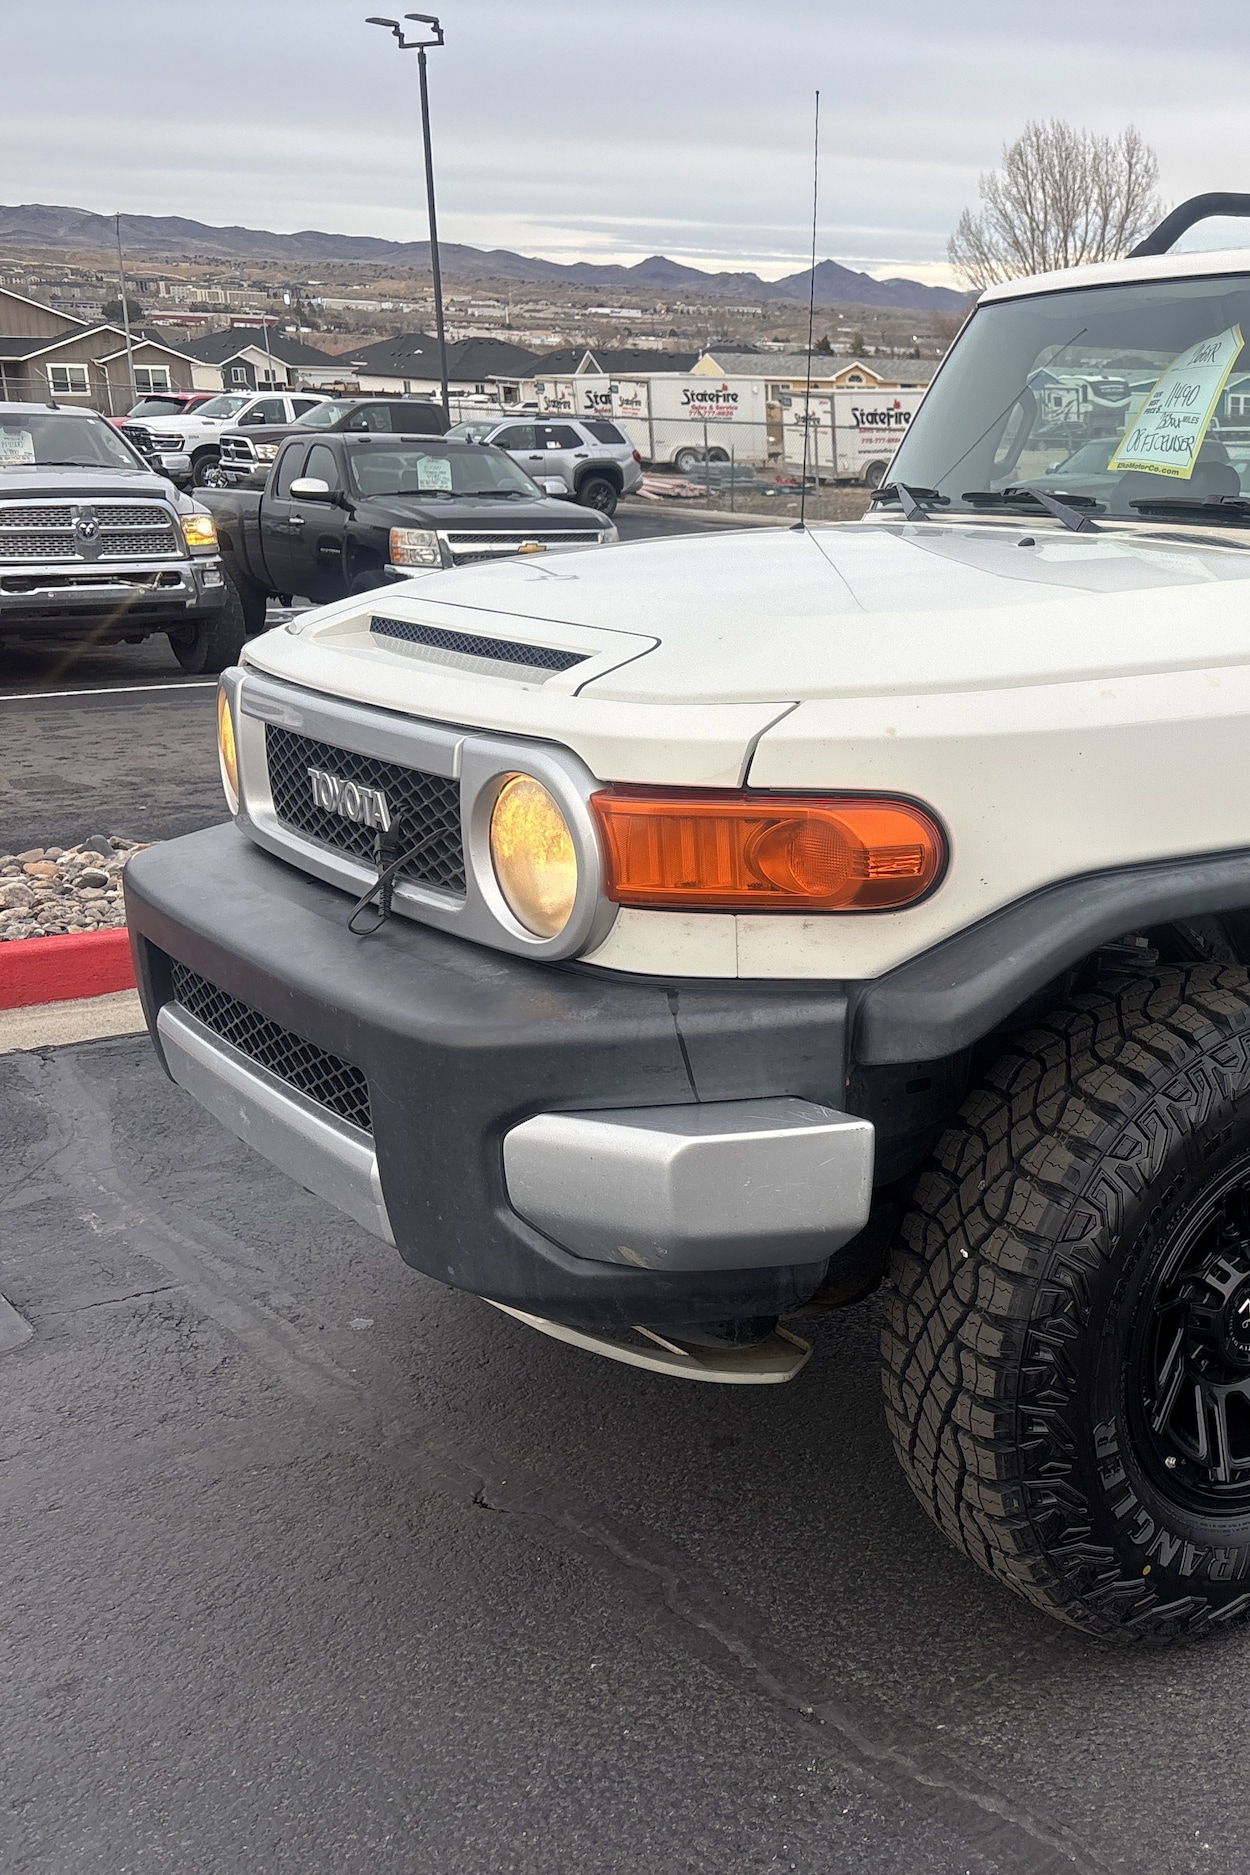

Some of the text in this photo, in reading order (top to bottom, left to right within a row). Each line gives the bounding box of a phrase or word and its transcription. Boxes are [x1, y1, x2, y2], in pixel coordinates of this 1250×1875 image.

[680, 389, 739, 405] StateFire
[1164, 382, 1201, 408] 11490
[851, 407, 911, 428] StateFire
[1180, 416, 1200, 425] MILES
[307, 766, 391, 832] TOYOTA
